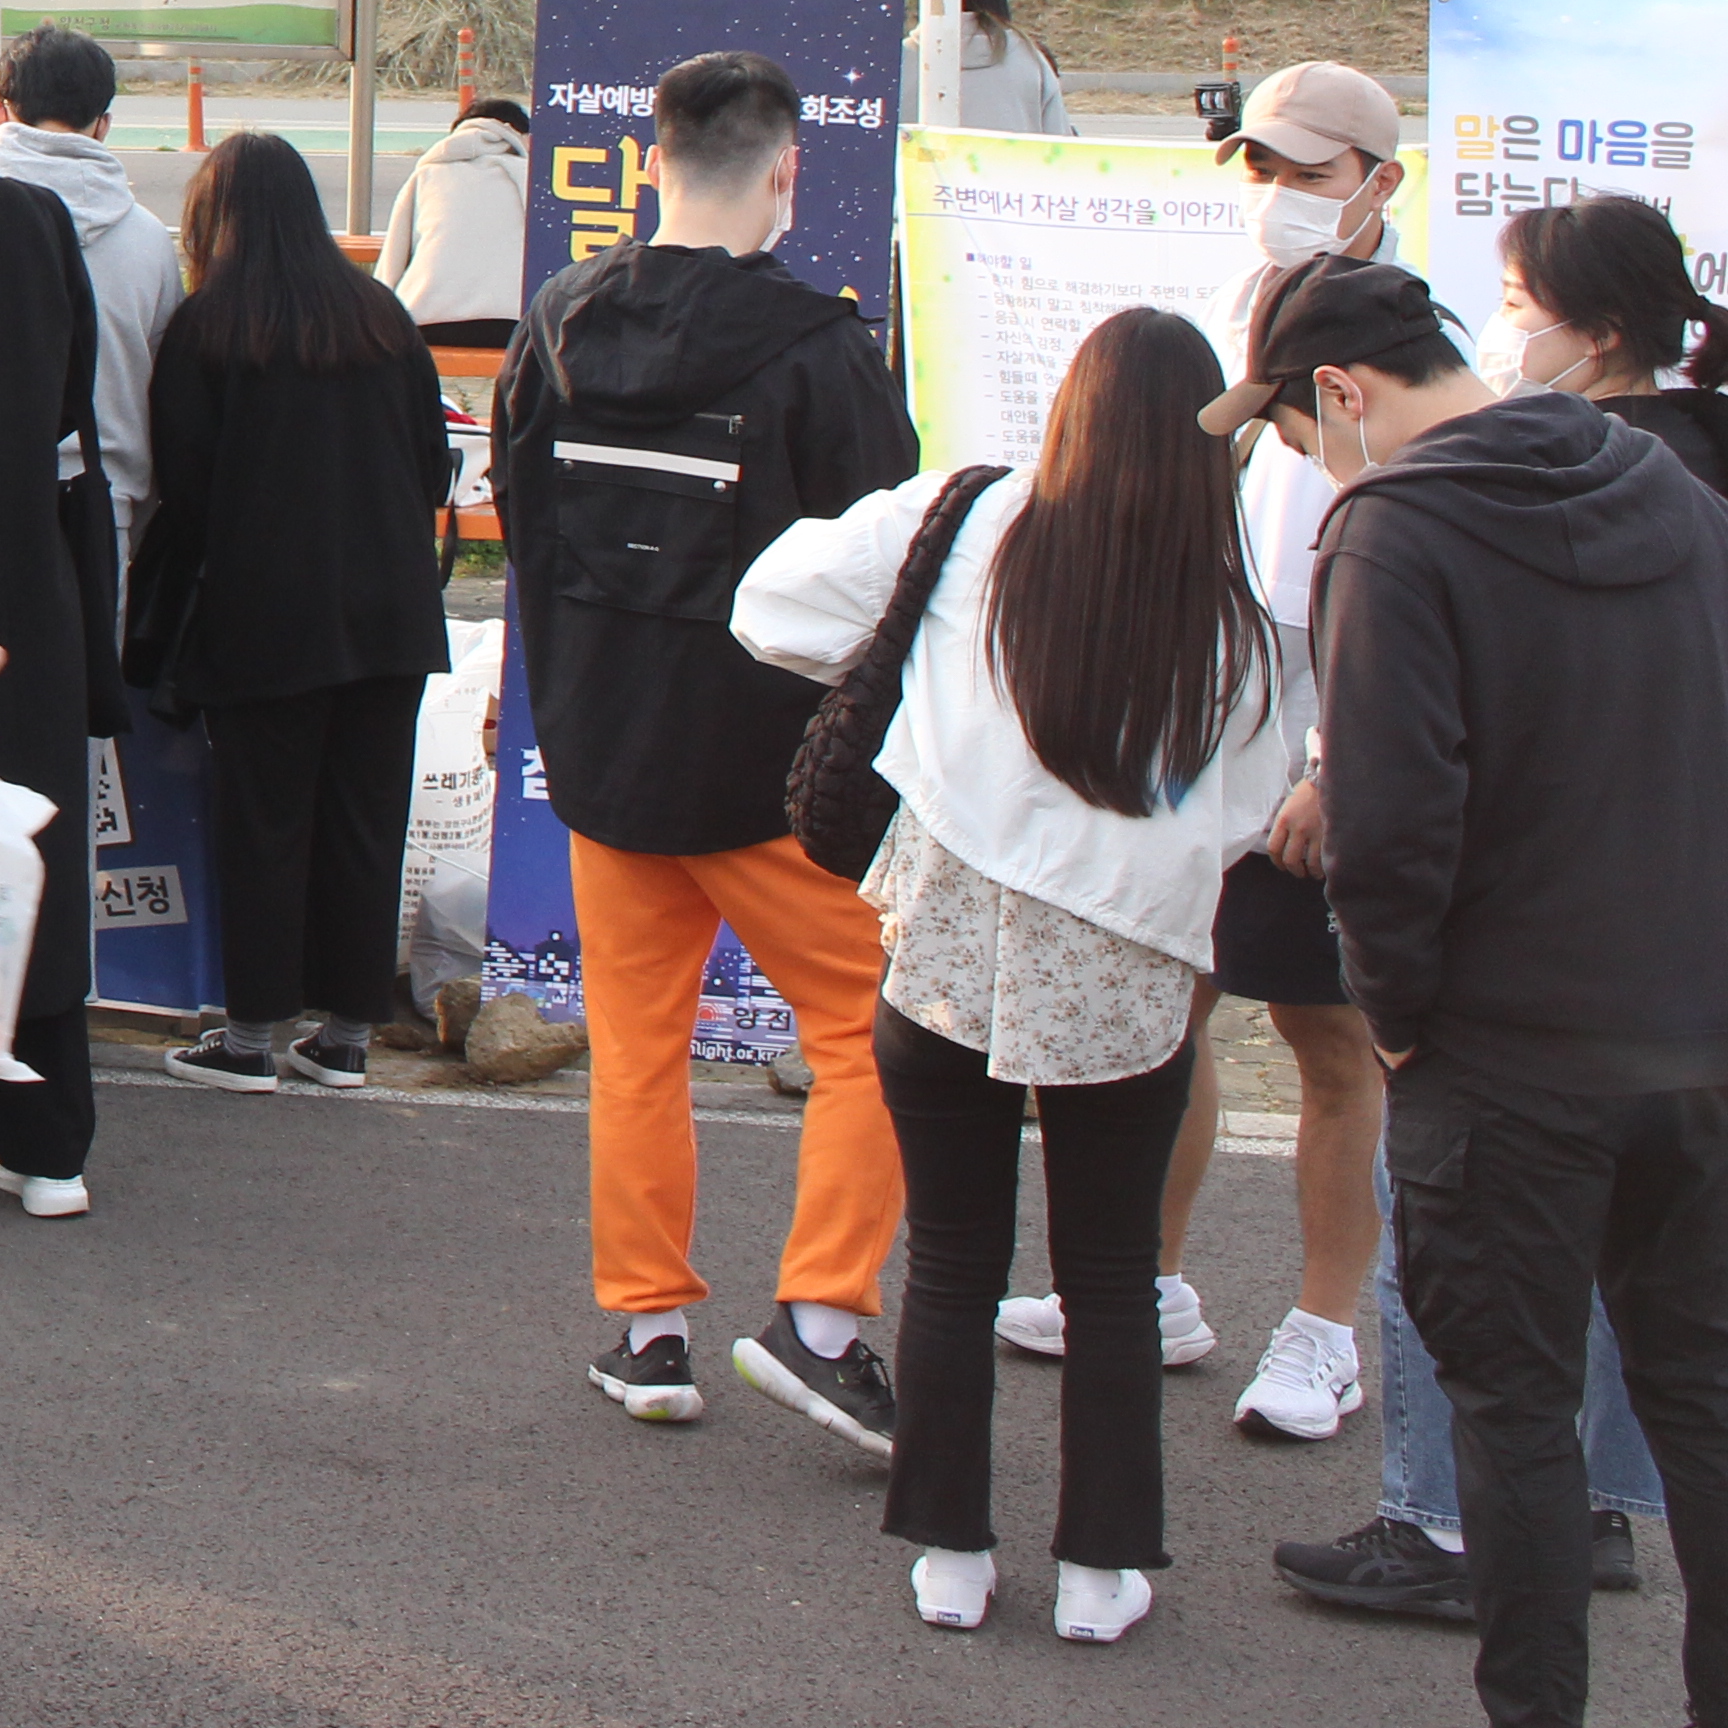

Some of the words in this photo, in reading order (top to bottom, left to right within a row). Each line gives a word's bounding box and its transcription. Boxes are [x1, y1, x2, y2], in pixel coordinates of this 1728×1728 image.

[548, 82, 657, 117] 자살예방
[1454, 114, 1542, 162] 말은
[1557, 118, 1695, 170] 마음을
[933, 184, 1024, 218] 주변에서
[1031, 193, 1080, 222] 자살
[1085, 197, 1156, 226] 생각을
[1163, 200, 1246, 229] 이야기
[977, 253, 1012, 269] 해야할
[1019, 256, 1032, 271] 일
[1021, 275, 1059, 291] 힘으로
[1064, 280, 1143, 298] 해결하기보다
[1148, 285, 1190, 300] 주변의
[1047, 297, 1074, 312] 말고
[994, 309, 1019, 326] 응급
[1040, 316, 1081, 332] 연락할
[999, 371, 1038, 386] 힘들때
[1000, 389, 1039, 406] 도움을
[1001, 409, 1039, 426] 대안을
[1002, 429, 1041, 445] 도움을
